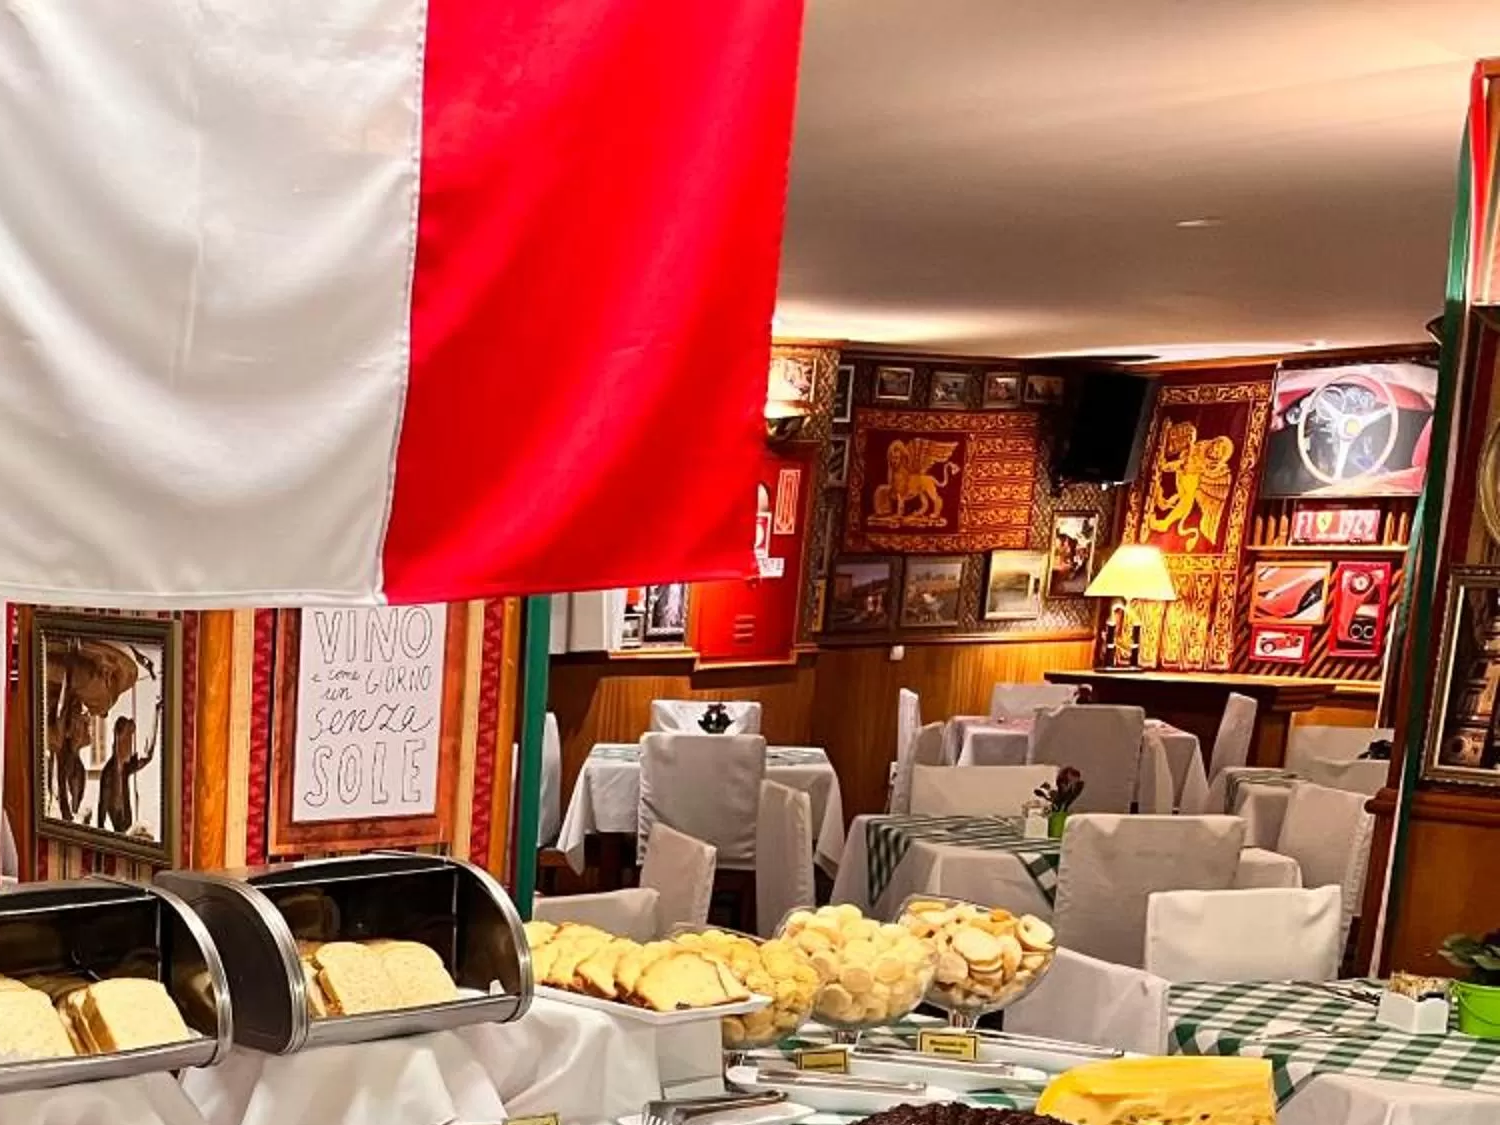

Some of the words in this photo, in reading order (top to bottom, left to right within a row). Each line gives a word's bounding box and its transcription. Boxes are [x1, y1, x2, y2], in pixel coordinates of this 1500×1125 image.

[314, 605, 433, 664] VINO
[365, 665, 432, 695] GIORNO
[303, 739, 426, 807] SOLE
